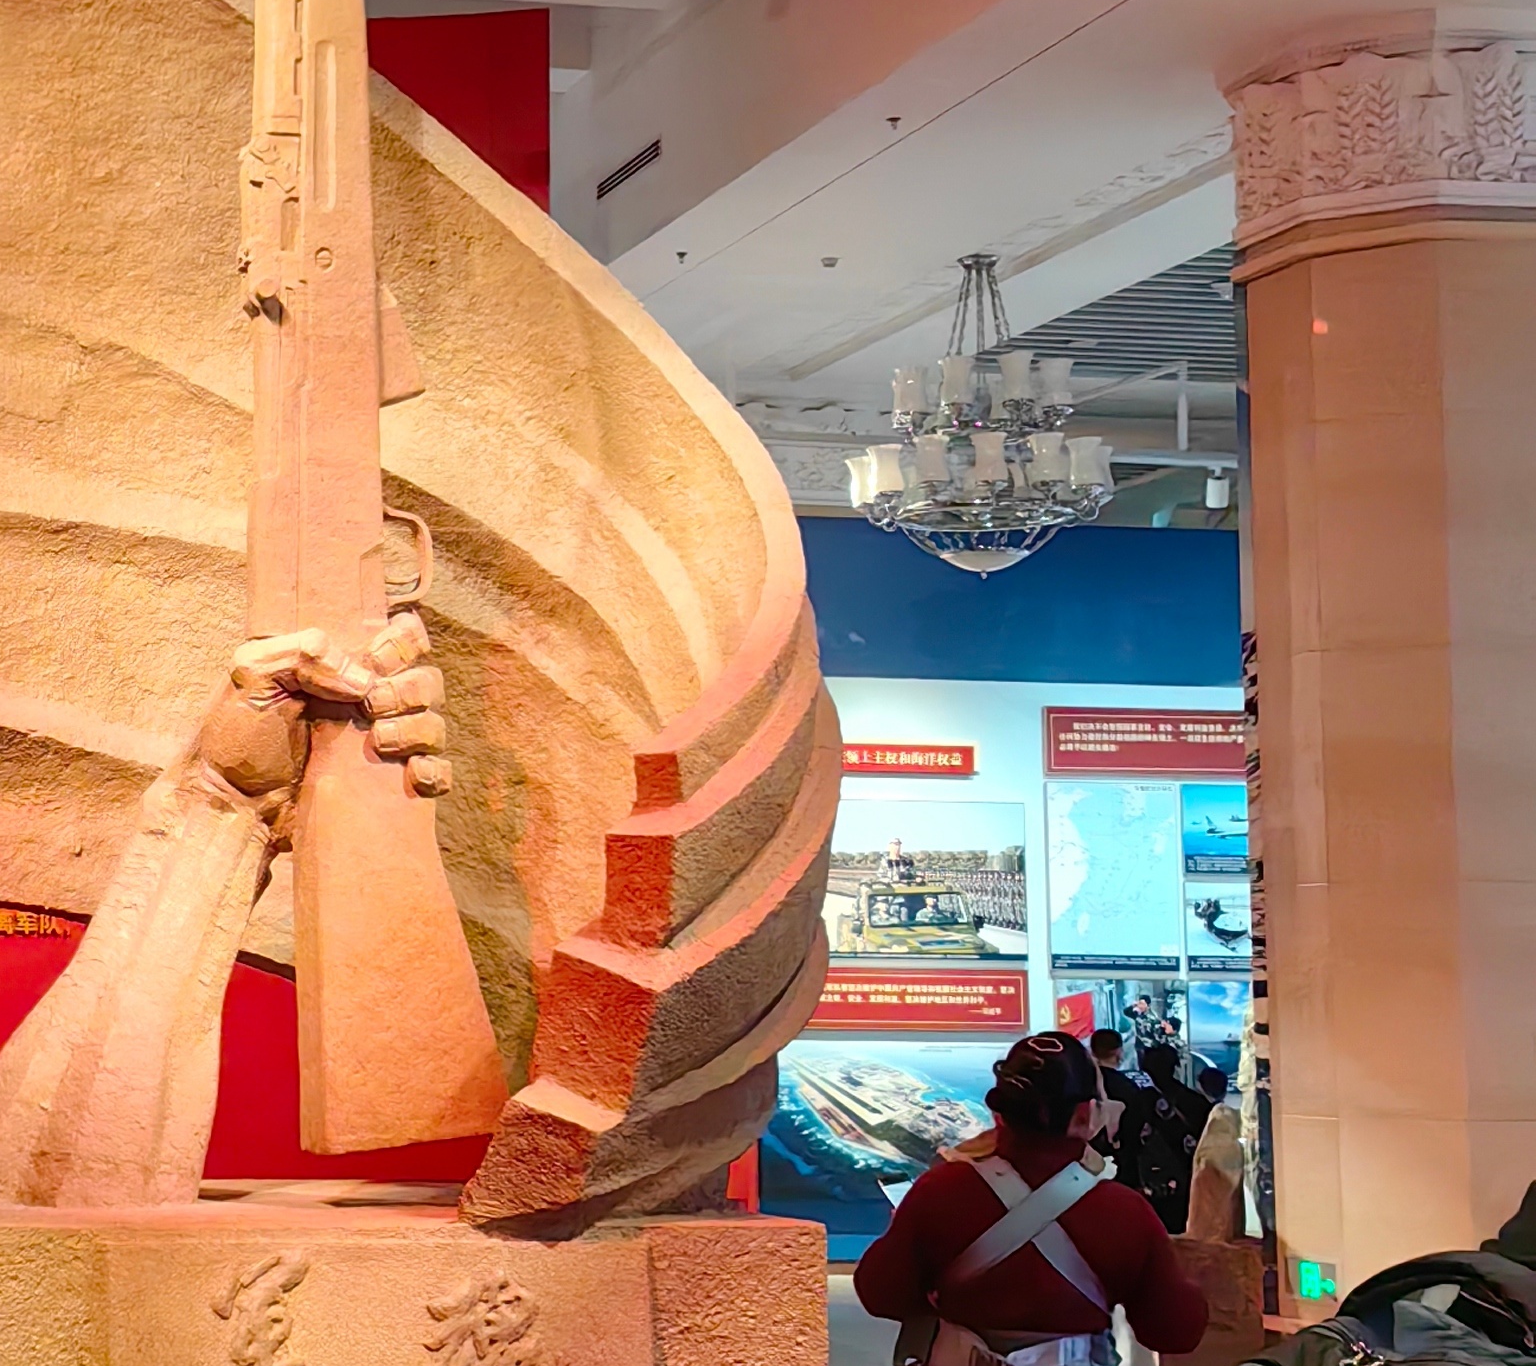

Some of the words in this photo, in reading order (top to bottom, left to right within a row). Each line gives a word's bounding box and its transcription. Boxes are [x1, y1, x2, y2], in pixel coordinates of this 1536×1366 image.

[842, 749, 962, 766] 领土主权和海洋权益
